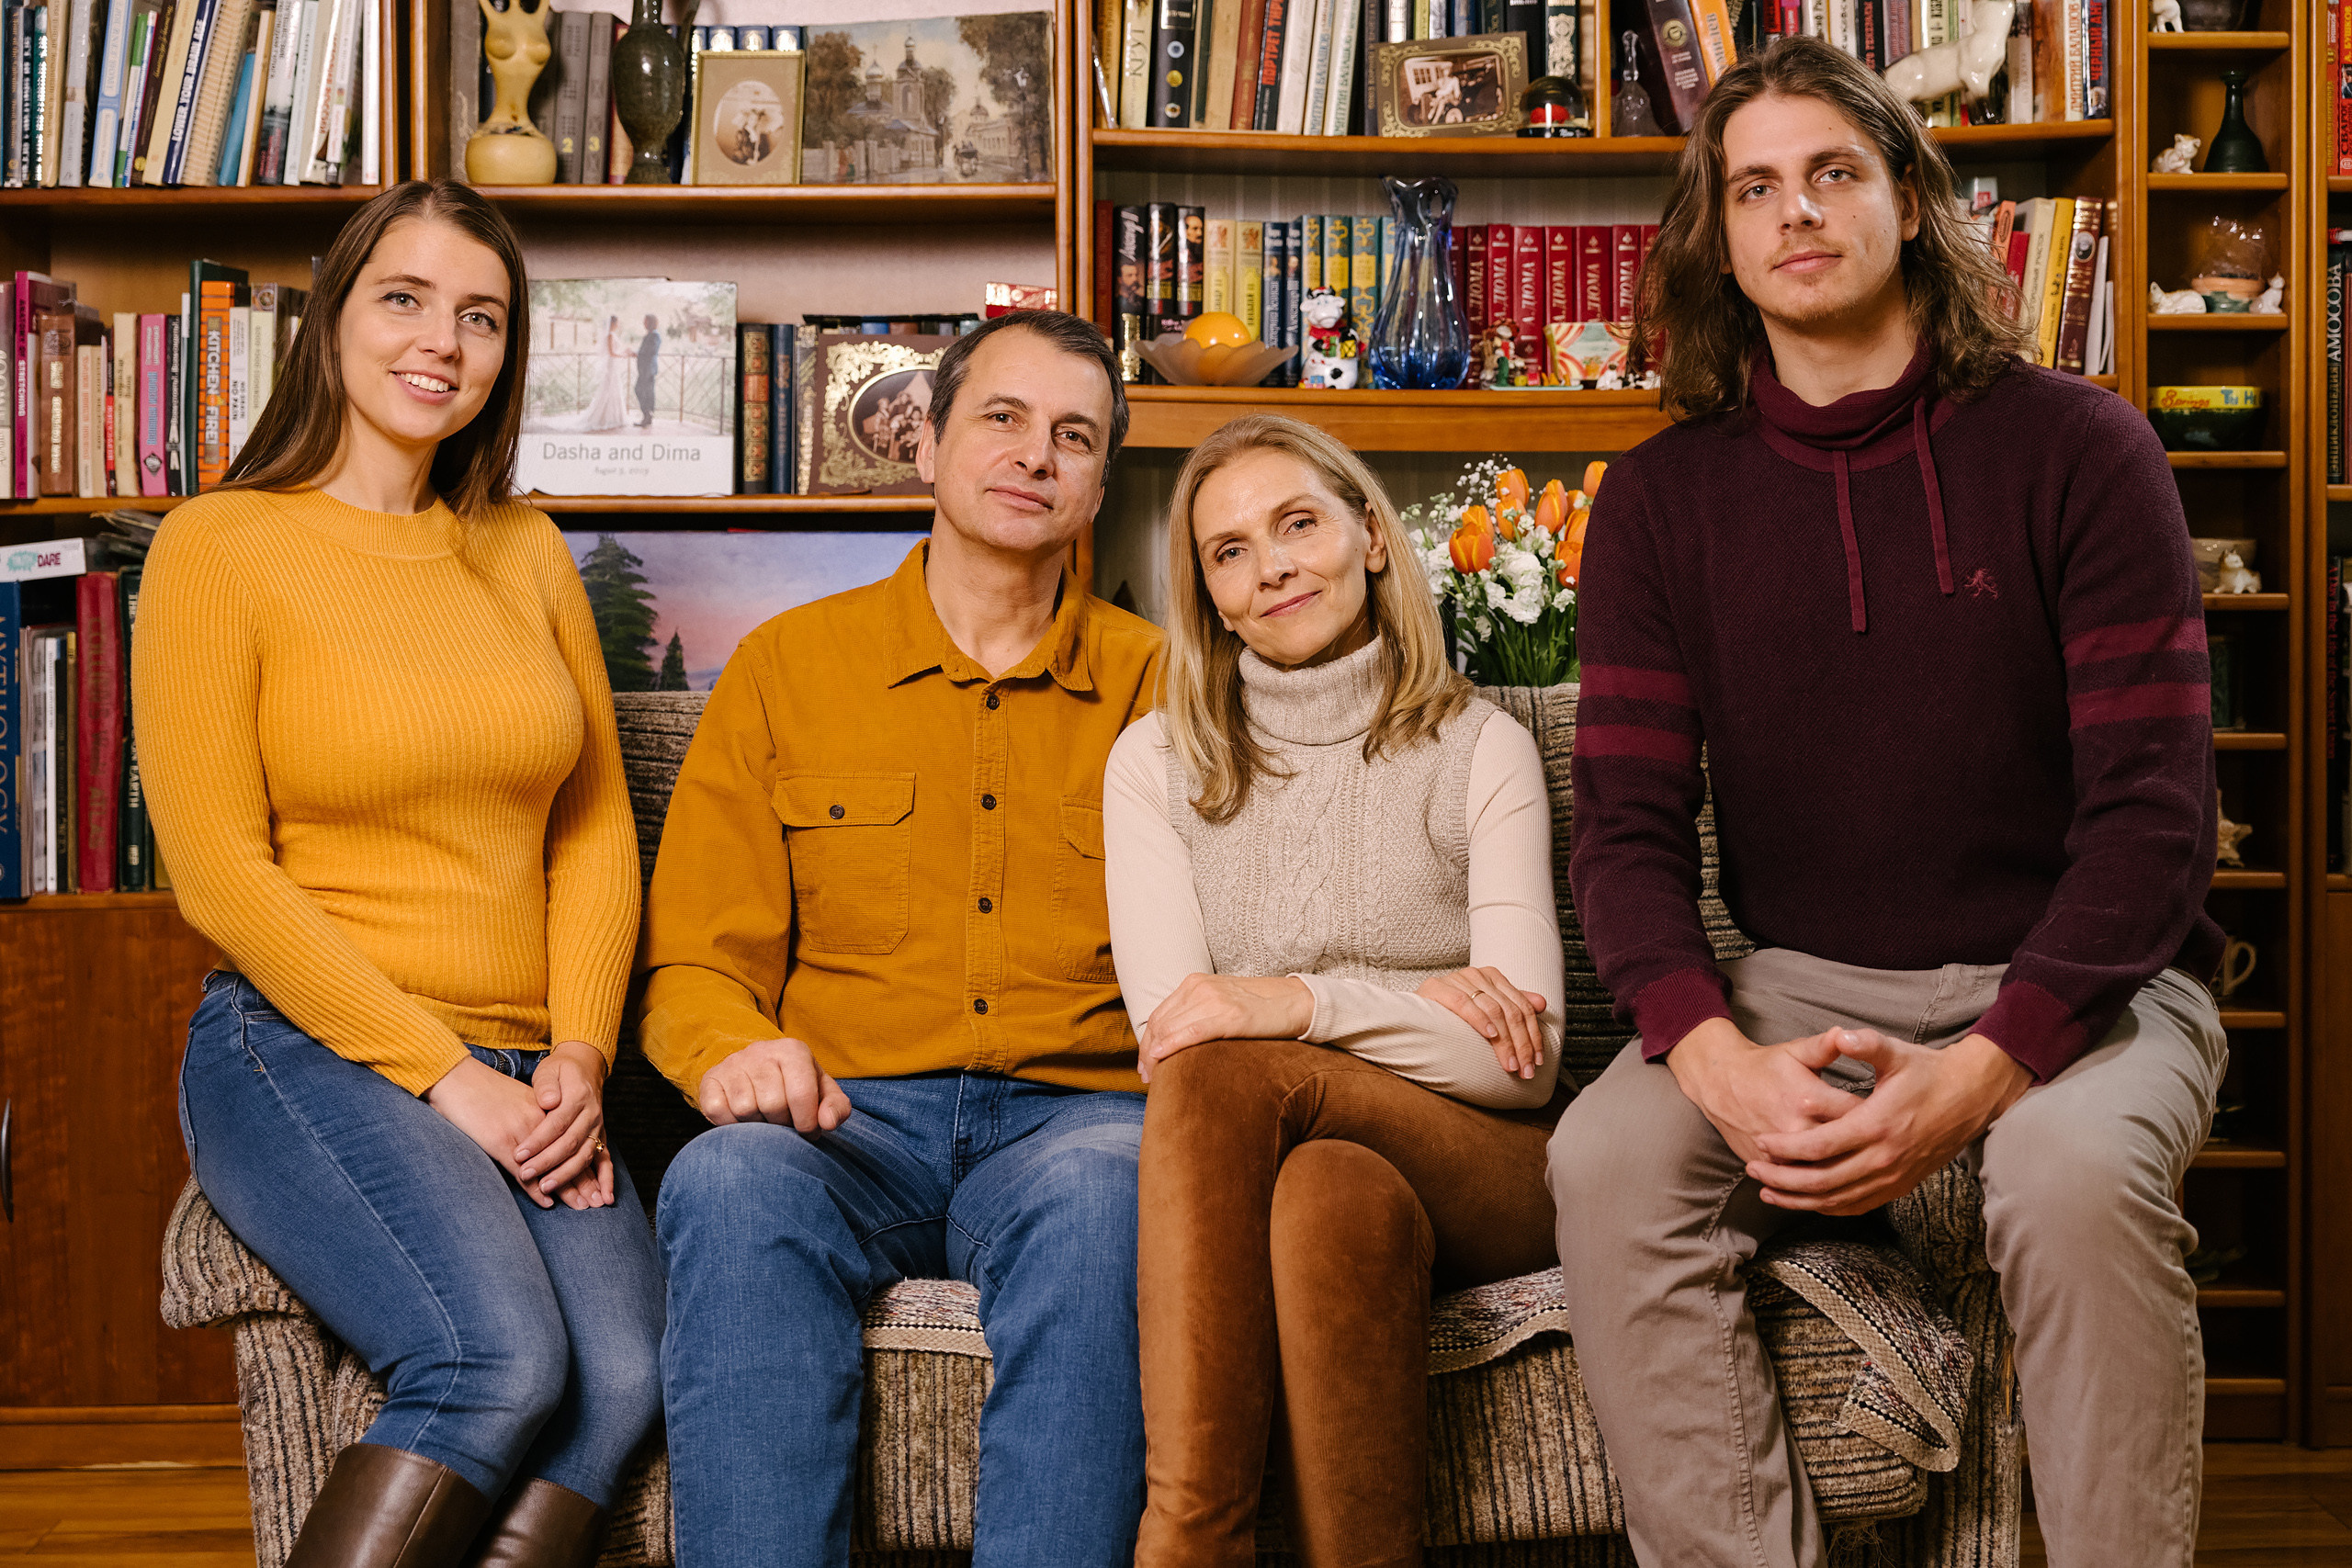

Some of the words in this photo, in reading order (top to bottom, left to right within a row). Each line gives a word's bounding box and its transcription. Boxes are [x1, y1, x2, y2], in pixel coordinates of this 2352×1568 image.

[193, 19, 205, 39] AGE
[2068, 4, 2081, 56] БАЛАШОВ
[2344, 6, 2352, 49] БУШКОВ
[186, 41, 202, 74] BRAIN
[1261, 29, 1281, 85] ПОРТРЕТ
[2088, 27, 2102, 81] ЧЕРНЫЙ
[179, 76, 194, 104] YOUR
[2069, 61, 2082, 112] ДМИТРИЙ
[171, 107, 188, 141] LOWER
[561, 138, 573, 153] 2
[588, 137, 600, 152] 3
[2327, 263, 2341, 362] АМОСОВА
[207, 330, 220, 395] KITCHEN
[17, 360, 26, 416] STRETCHING
[205, 406, 220, 445] FIRE!
[2328, 365, 2340, 473] ЭНЦИКЛОПЕДИЯ
[543, 442, 601, 460] Dasha
[608, 444, 643, 461] and
[651, 444, 701, 461] Dima
[38, 553, 61, 567] DARE
[129, 765, 140, 808] EARTH
